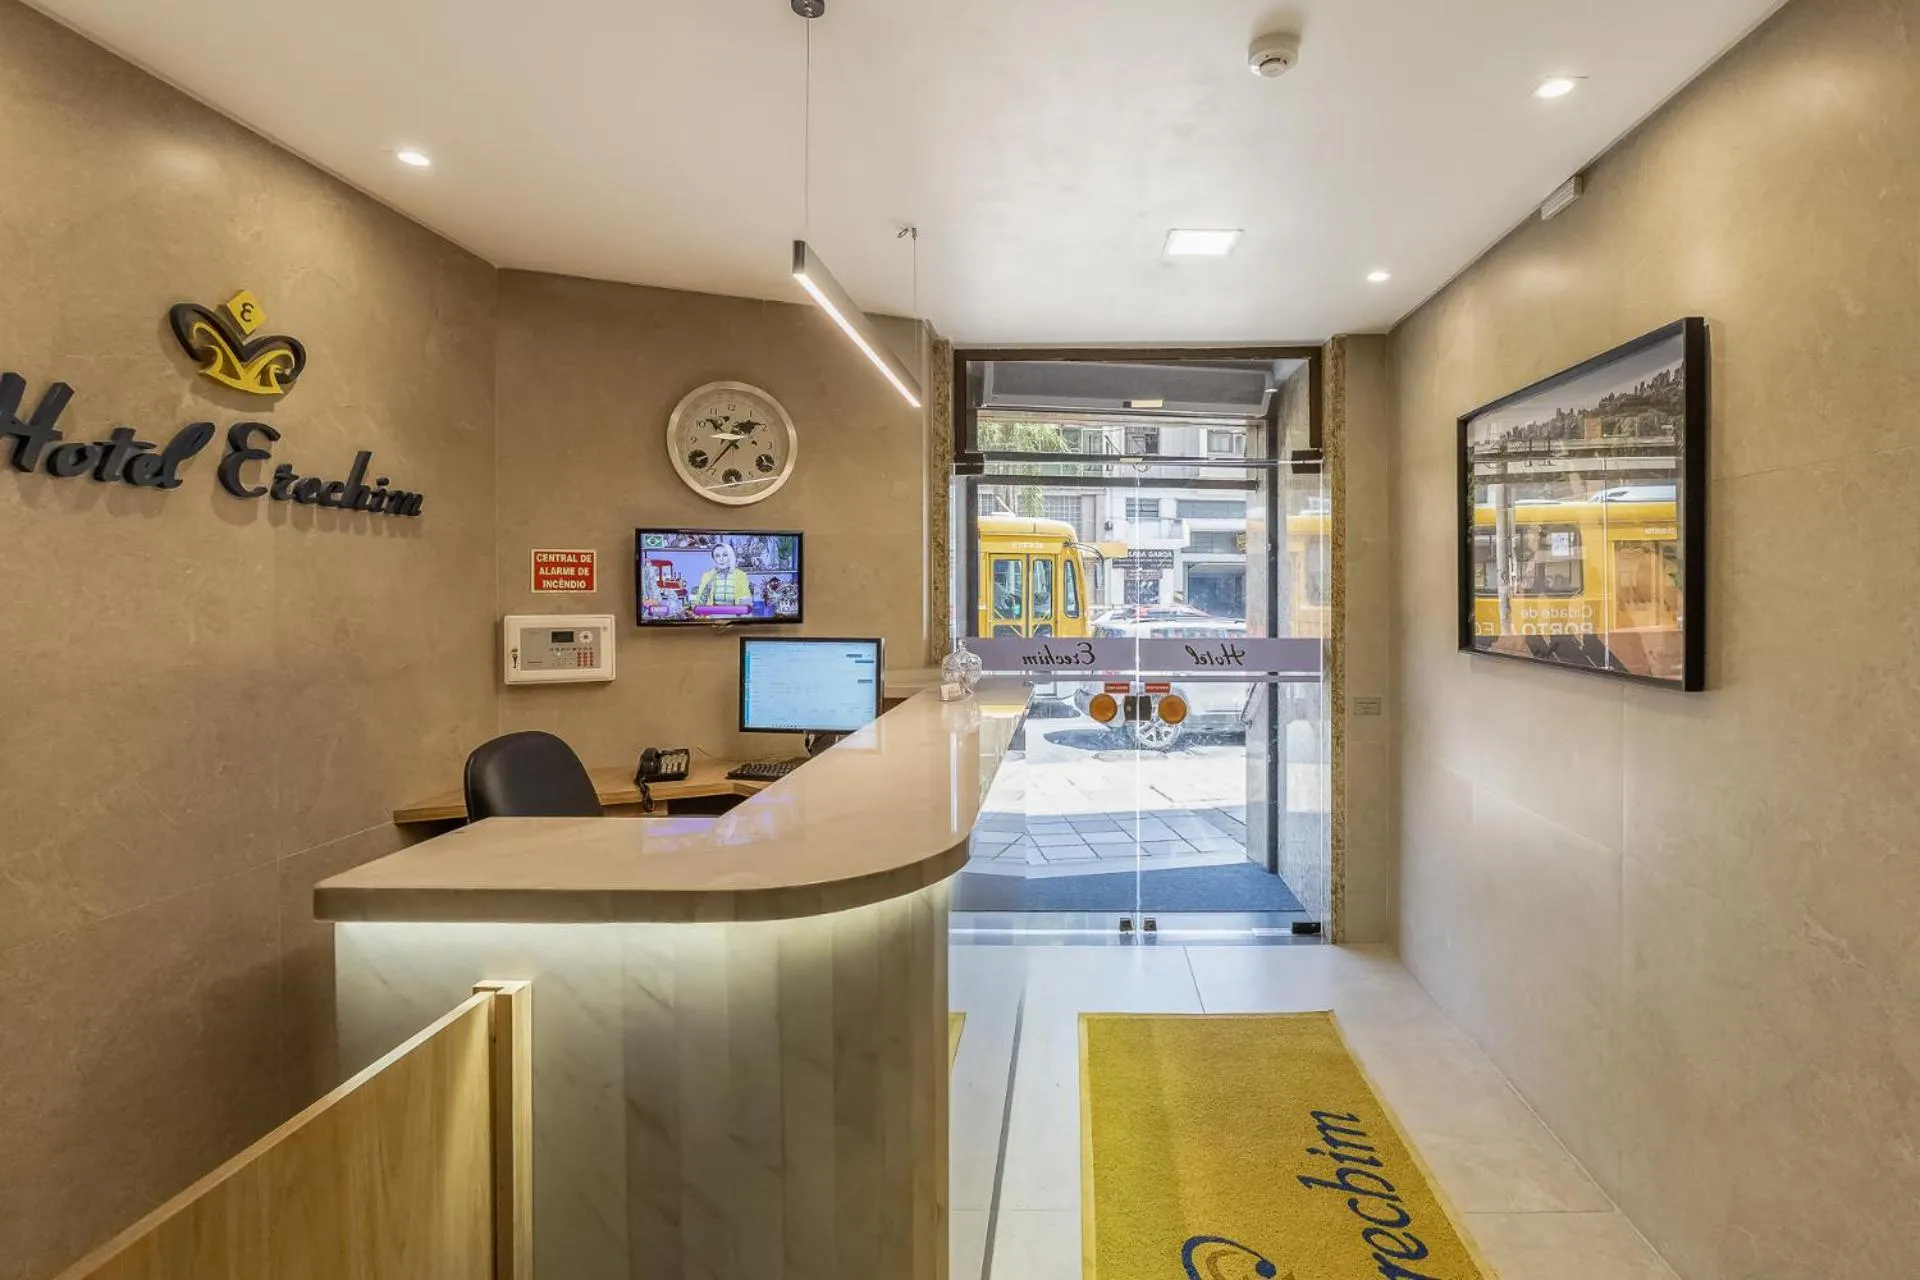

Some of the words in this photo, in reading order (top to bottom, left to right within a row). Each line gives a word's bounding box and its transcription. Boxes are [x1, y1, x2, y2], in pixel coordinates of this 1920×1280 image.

[0, 372, 216, 489] Hotel
[217, 422, 423, 517] Erechim
[536, 553, 578, 563] CENTRAL
[580, 553, 592, 563] DE
[539, 566, 575, 576] ALARME
[577, 567, 590, 576] DE
[542, 577, 586, 589] INCÊNDIO
